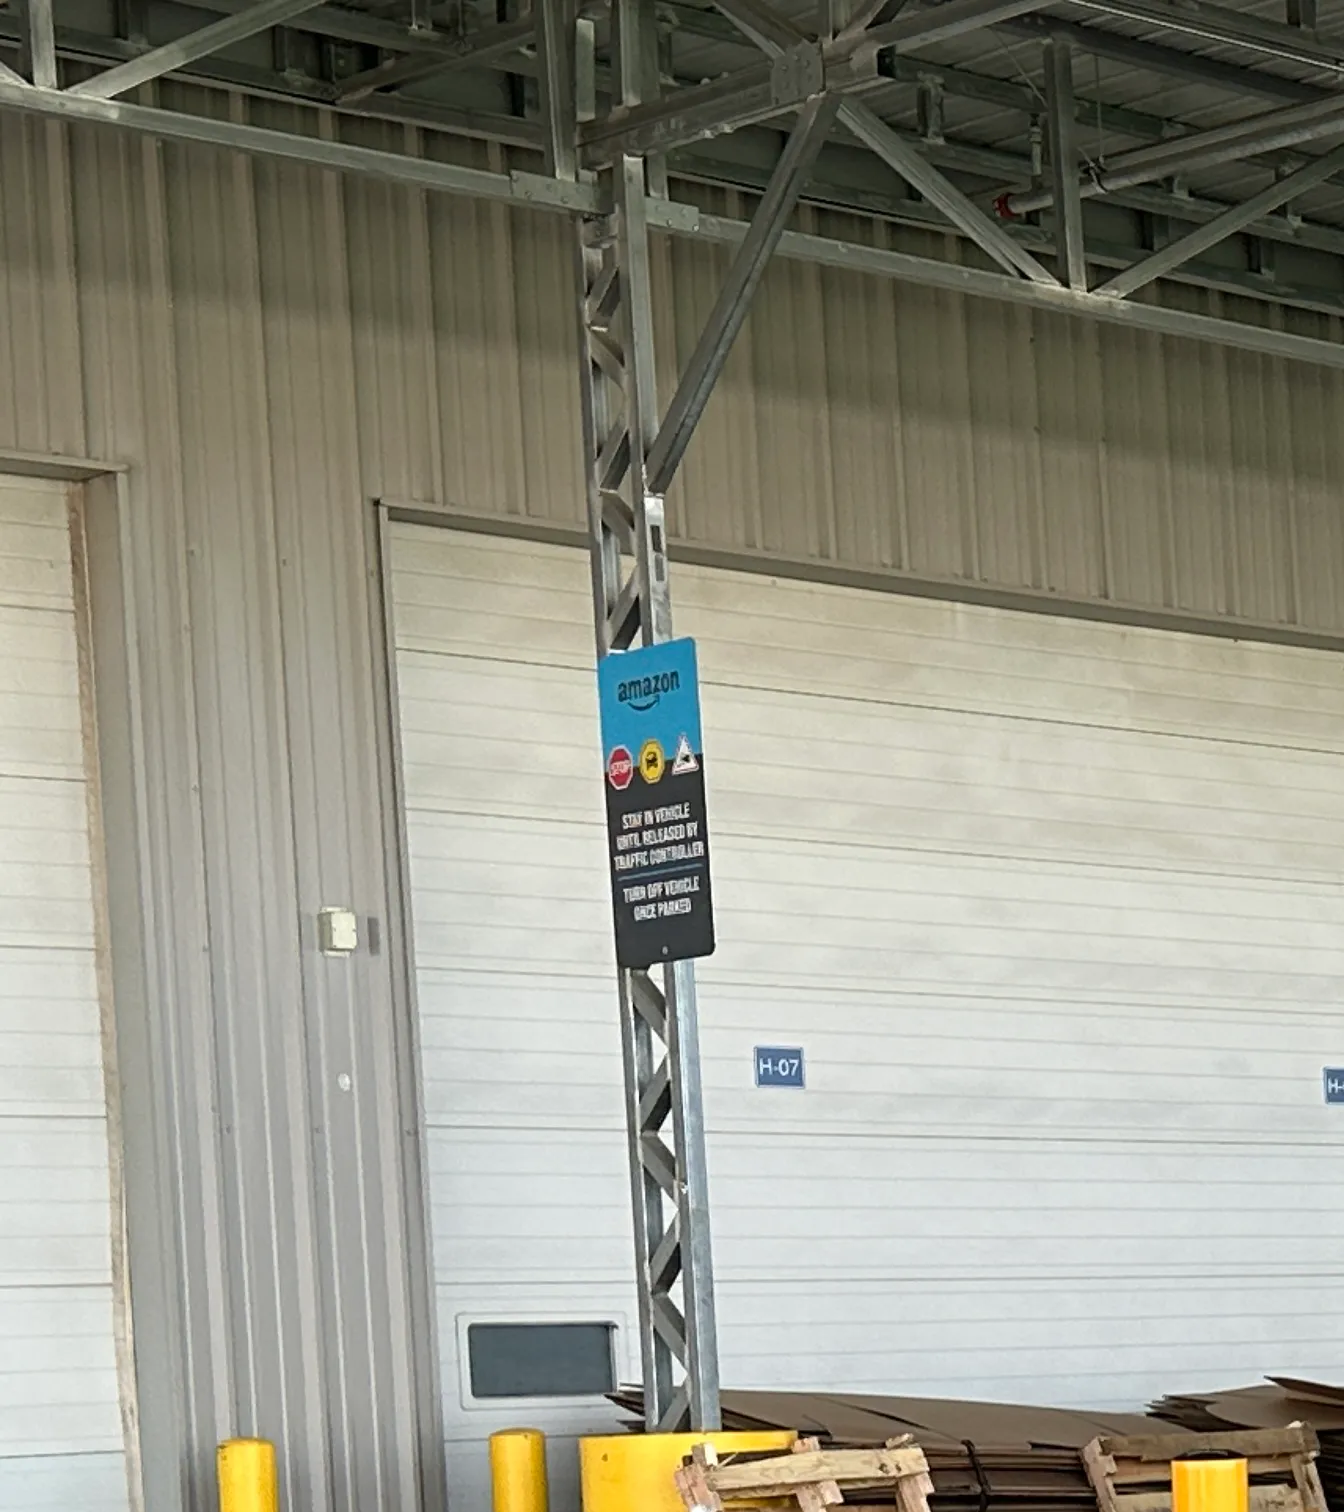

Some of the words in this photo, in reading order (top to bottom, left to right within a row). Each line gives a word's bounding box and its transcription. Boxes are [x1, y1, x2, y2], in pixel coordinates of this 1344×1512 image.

[617, 670, 680, 702] amazon
[622, 812, 642, 830] STAY
[644, 809, 654, 825] IN
[655, 802, 691, 823] VEHICLE
[616, 831, 641, 851] UNTIL
[643, 824, 685, 845] RELEASED
[686, 821, 698, 838] BY
[614, 850, 648, 871] TRAFFIC
[650, 841, 704, 865] CONTROLLER
[623, 885, 646, 903] TURN
[647, 882, 664, 901] OFF
[664, 875, 700, 897] VEHICLE
[633, 903, 657, 921] ONCE
[657, 897, 692, 918] PARKED
[759, 1057, 799, 1076] H-07
